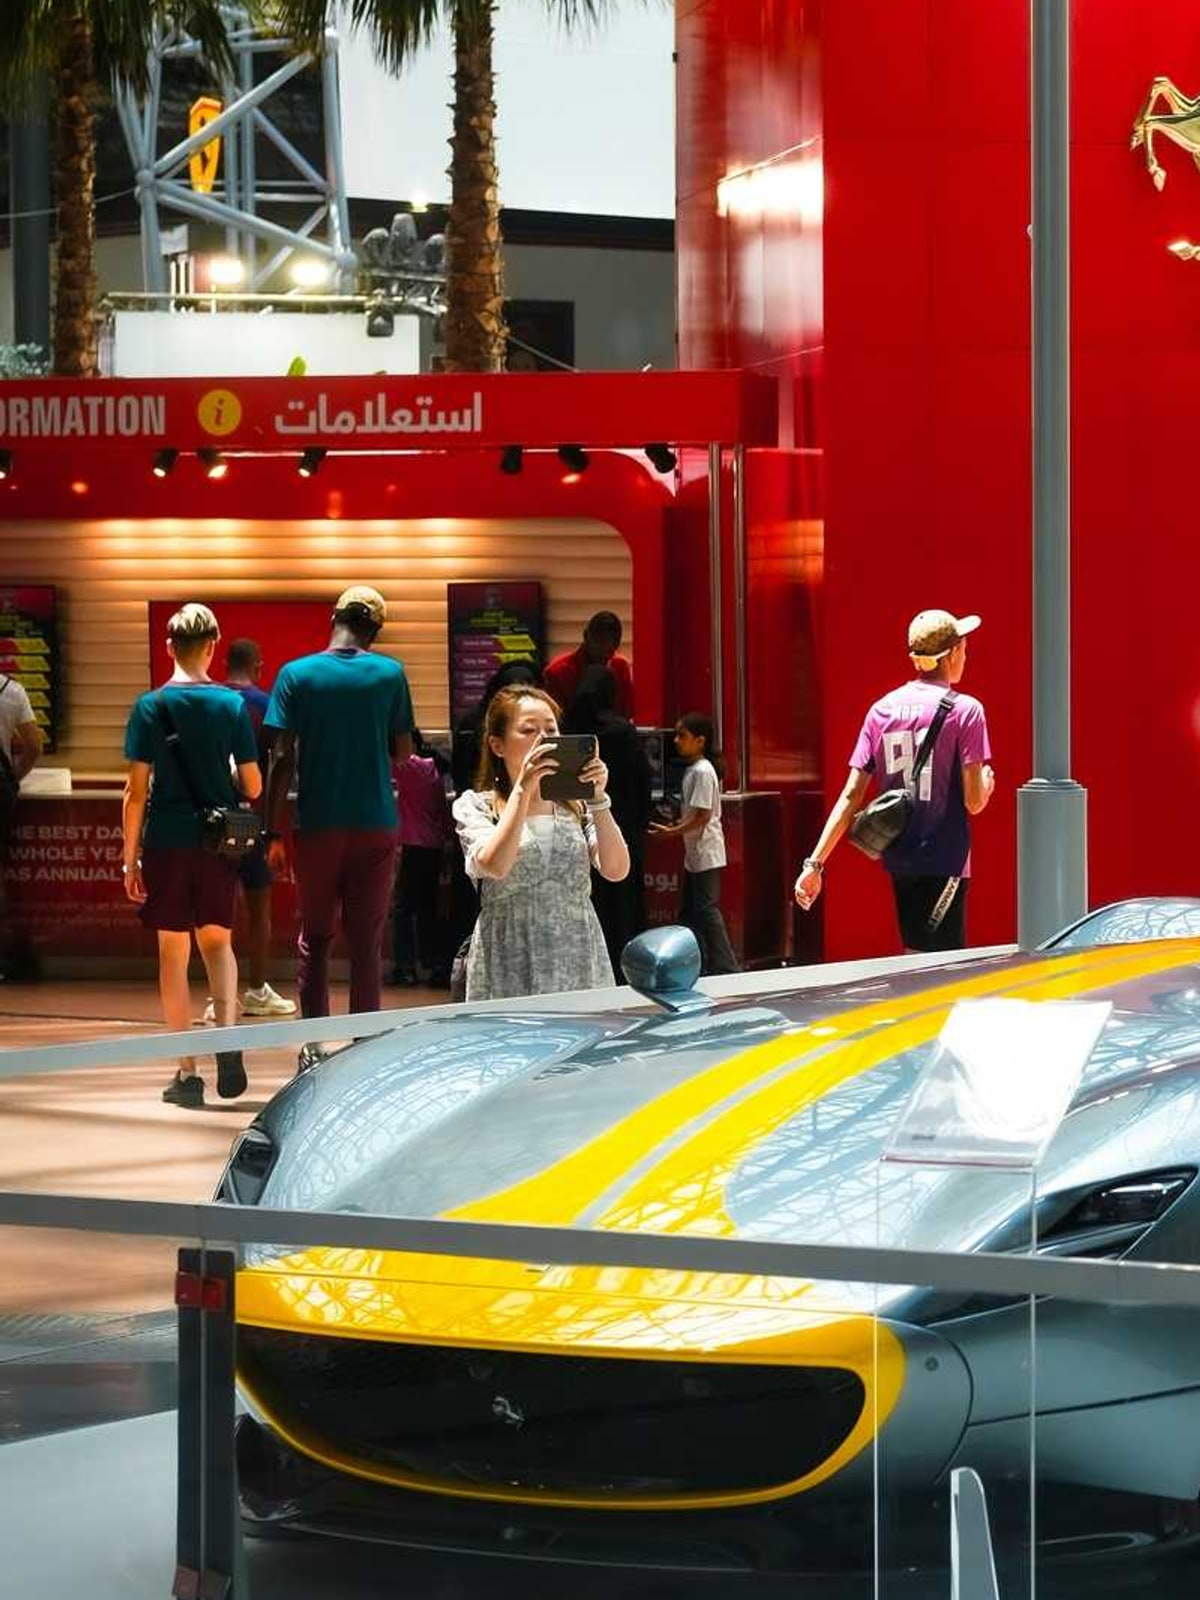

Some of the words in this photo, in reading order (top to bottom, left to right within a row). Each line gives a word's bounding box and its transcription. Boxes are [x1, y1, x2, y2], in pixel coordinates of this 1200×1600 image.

[274, 392, 482, 434] استعلامات
[38, 825, 93, 840] BEST
[10, 846, 86, 862] WHOLE
[34, 867, 121, 882] ANNUAL
